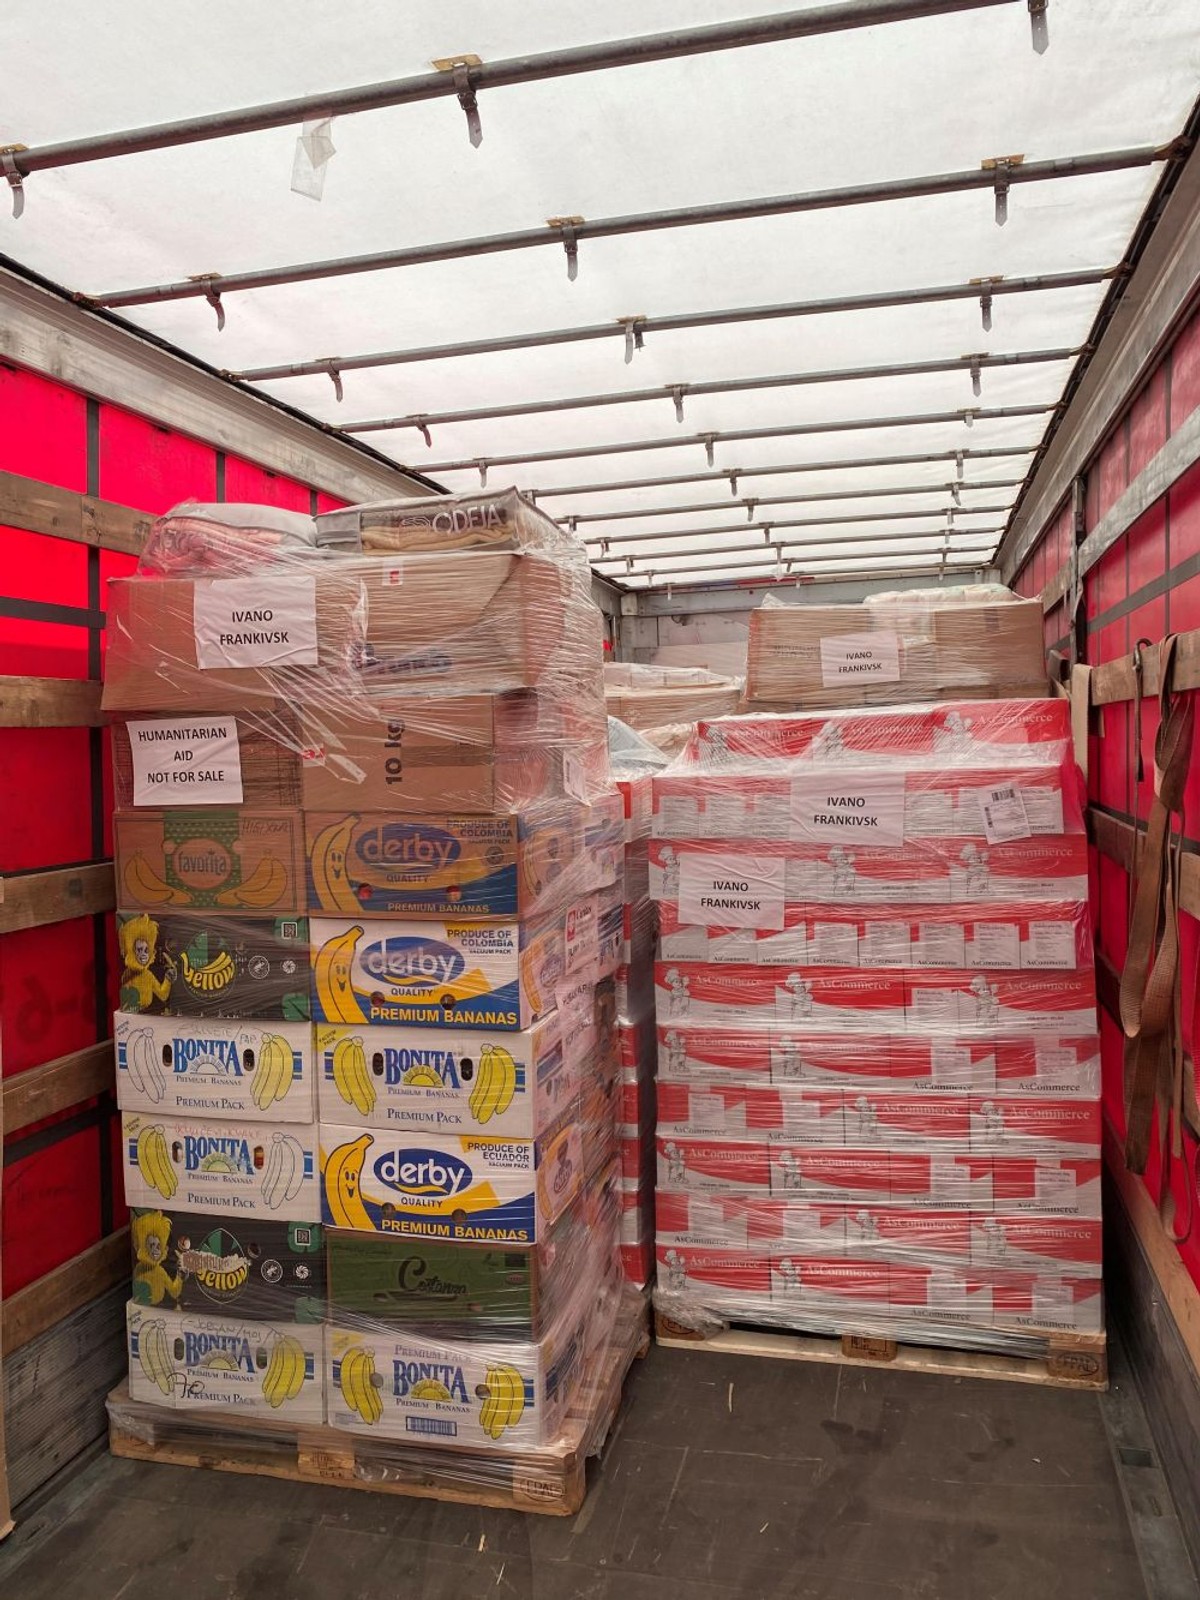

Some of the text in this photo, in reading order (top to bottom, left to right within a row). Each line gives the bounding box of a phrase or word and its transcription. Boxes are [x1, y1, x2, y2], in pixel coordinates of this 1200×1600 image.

[231, 610, 274, 623] IVANO
[219, 632, 289, 646] FRANKIVSK
[845, 650, 873, 661] IVANO
[838, 662, 882, 674] FRANKIVSK
[138, 727, 227, 742] HUMANITARIAN
[173, 749, 194, 762] AID
[147, 769, 225, 784] NOT FOR SALE
[385, 757, 403, 785] 10
[826, 796, 866, 808] IVANO
[813, 813, 878, 827] FRANKIVSK
[459, 829, 513, 838] COLOMBIA
[363, 826, 453, 869] derby
[178, 851, 228, 876] favorita
[386, 873, 430, 884] QUALITY
[712, 880, 749, 892] IVANO
[387, 903, 490, 914] PREMIUM BANANAS
[700, 897, 761, 911] FRANKIVSK
[446, 929, 512, 940] PRODUCE OF
[461, 938, 514, 948] COLOMBIA
[367, 940, 456, 984] derby
[390, 988, 434, 998] QUALITY
[370, 1007, 517, 1025] PREMIUM BANANAS
[172, 1038, 244, 1077] BONITA
[383, 1048, 461, 1089] BONITA
[176, 1075, 242, 1086] PREMIUM BANANAS
[1018, 1082, 1080, 1091] AsCommerce
[387, 1087, 461, 1099] PREMIUM BANANAS
[175, 1096, 245, 1111] PREMIUM PACK
[387, 1108, 462, 1124] PREMIUM PACK
[1010, 1107, 1090, 1120] AsCommerce
[184, 1135, 255, 1175] BONITA
[467, 1142, 530, 1154] PRODUCE OF
[482, 1152, 530, 1163] ECUADOR
[187, 1173, 218, 1182] PREMIUM
[380, 1151, 466, 1195] derby
[187, 1193, 256, 1209] PREMIUM PACK
[400, 1198, 443, 1208] QUALITY
[381, 1219, 528, 1242] PREMIUM BANANAS
[1016, 1317, 1078, 1329] AsCommerce
[184, 1332, 256, 1374] BONITA
[394, 1344, 441, 1359] PREMIUM
[187, 1368, 254, 1382] PREMIUM BANANAS
[392, 1359, 472, 1404] BONITA
[186, 1389, 231, 1404] PREMIUM
[396, 1399, 471, 1413] PREMIUM BANANAS
